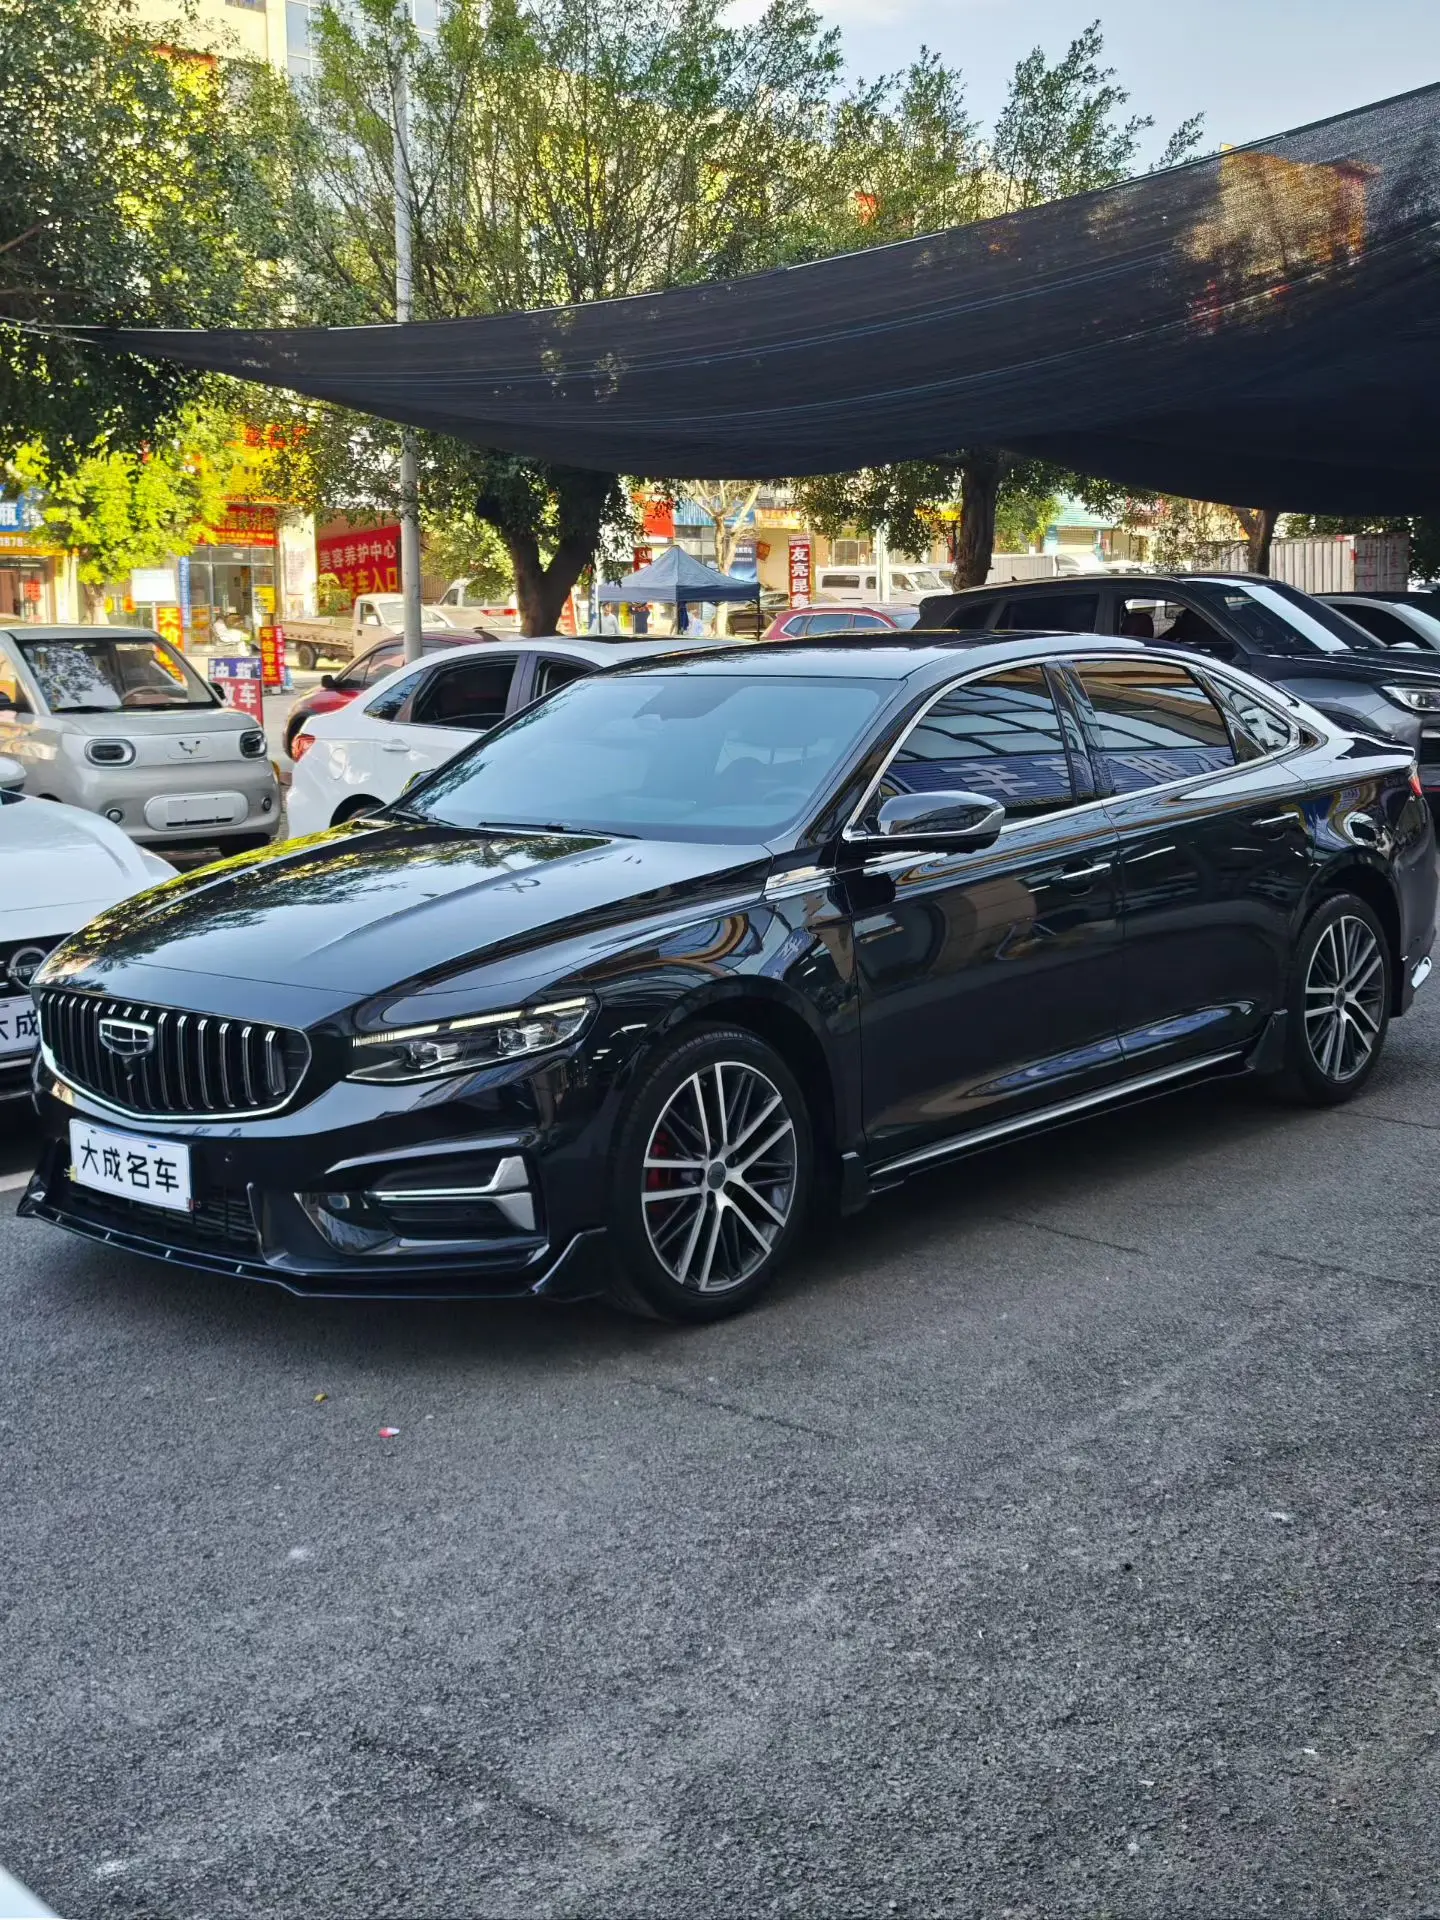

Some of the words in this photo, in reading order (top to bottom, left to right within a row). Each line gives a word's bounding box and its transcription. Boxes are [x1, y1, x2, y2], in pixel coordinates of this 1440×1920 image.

[320, 540, 396, 571] 美容养护中心
[80, 1138, 179, 1193] 大成名车
